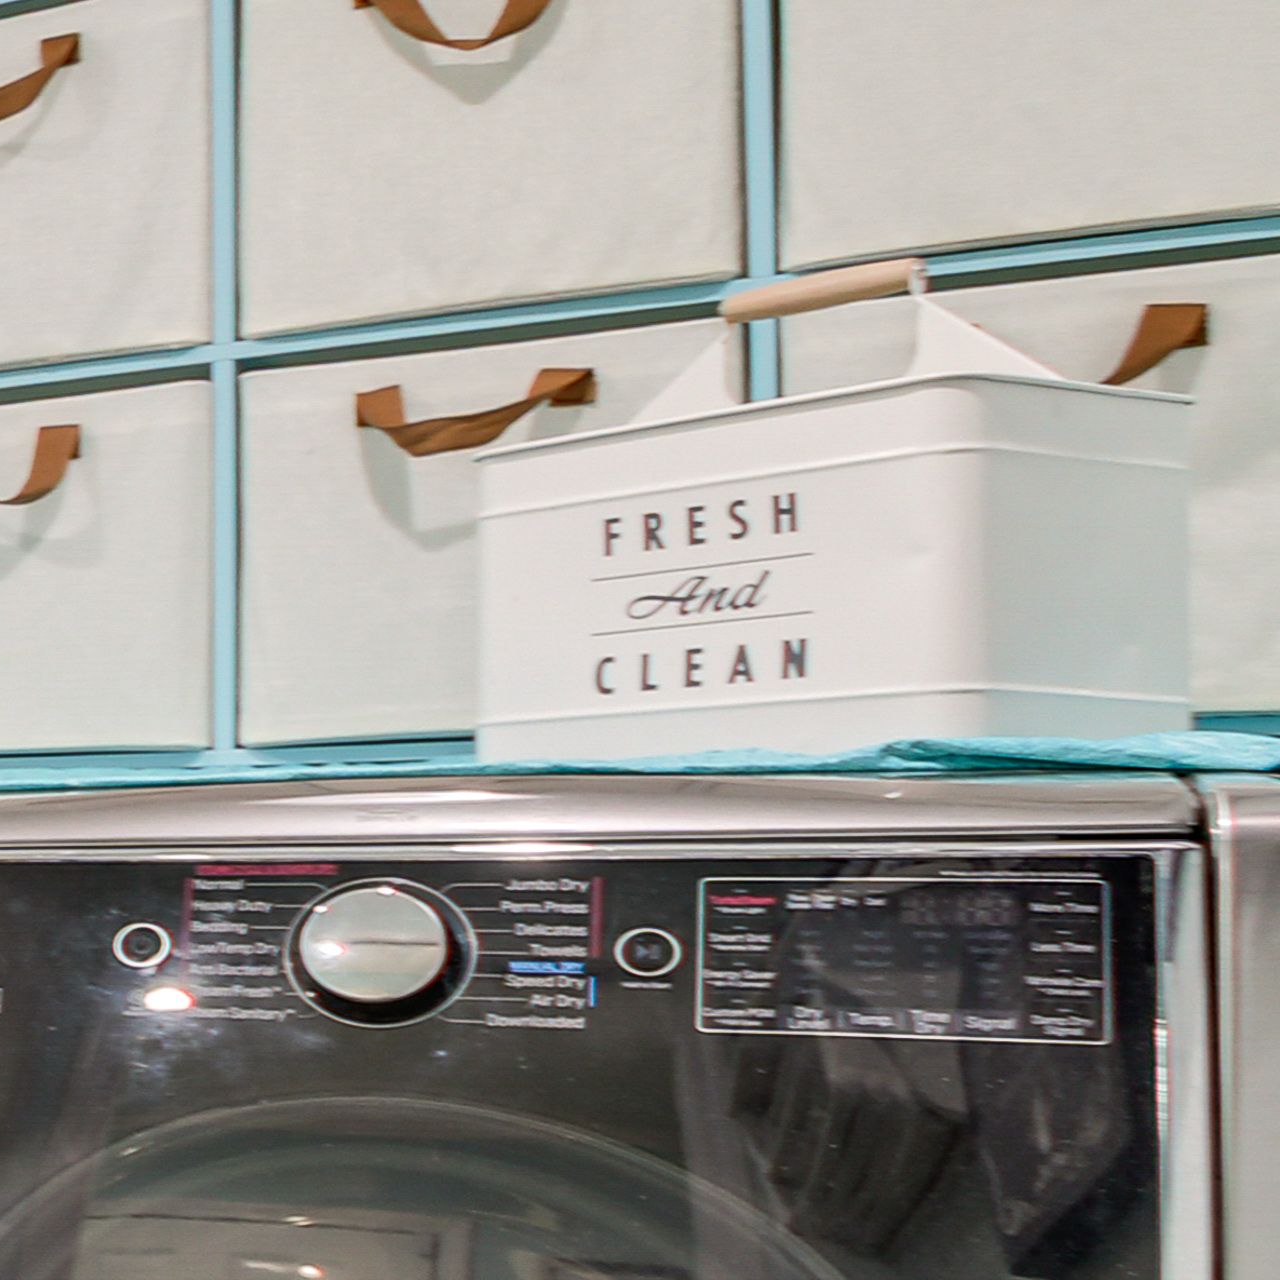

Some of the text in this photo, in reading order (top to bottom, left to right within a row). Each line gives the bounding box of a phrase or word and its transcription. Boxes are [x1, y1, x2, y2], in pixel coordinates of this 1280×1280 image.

[601, 491, 800, 557] FRESH
[625, 569, 772, 620] And
[594, 636, 809, 695] CLEAN
